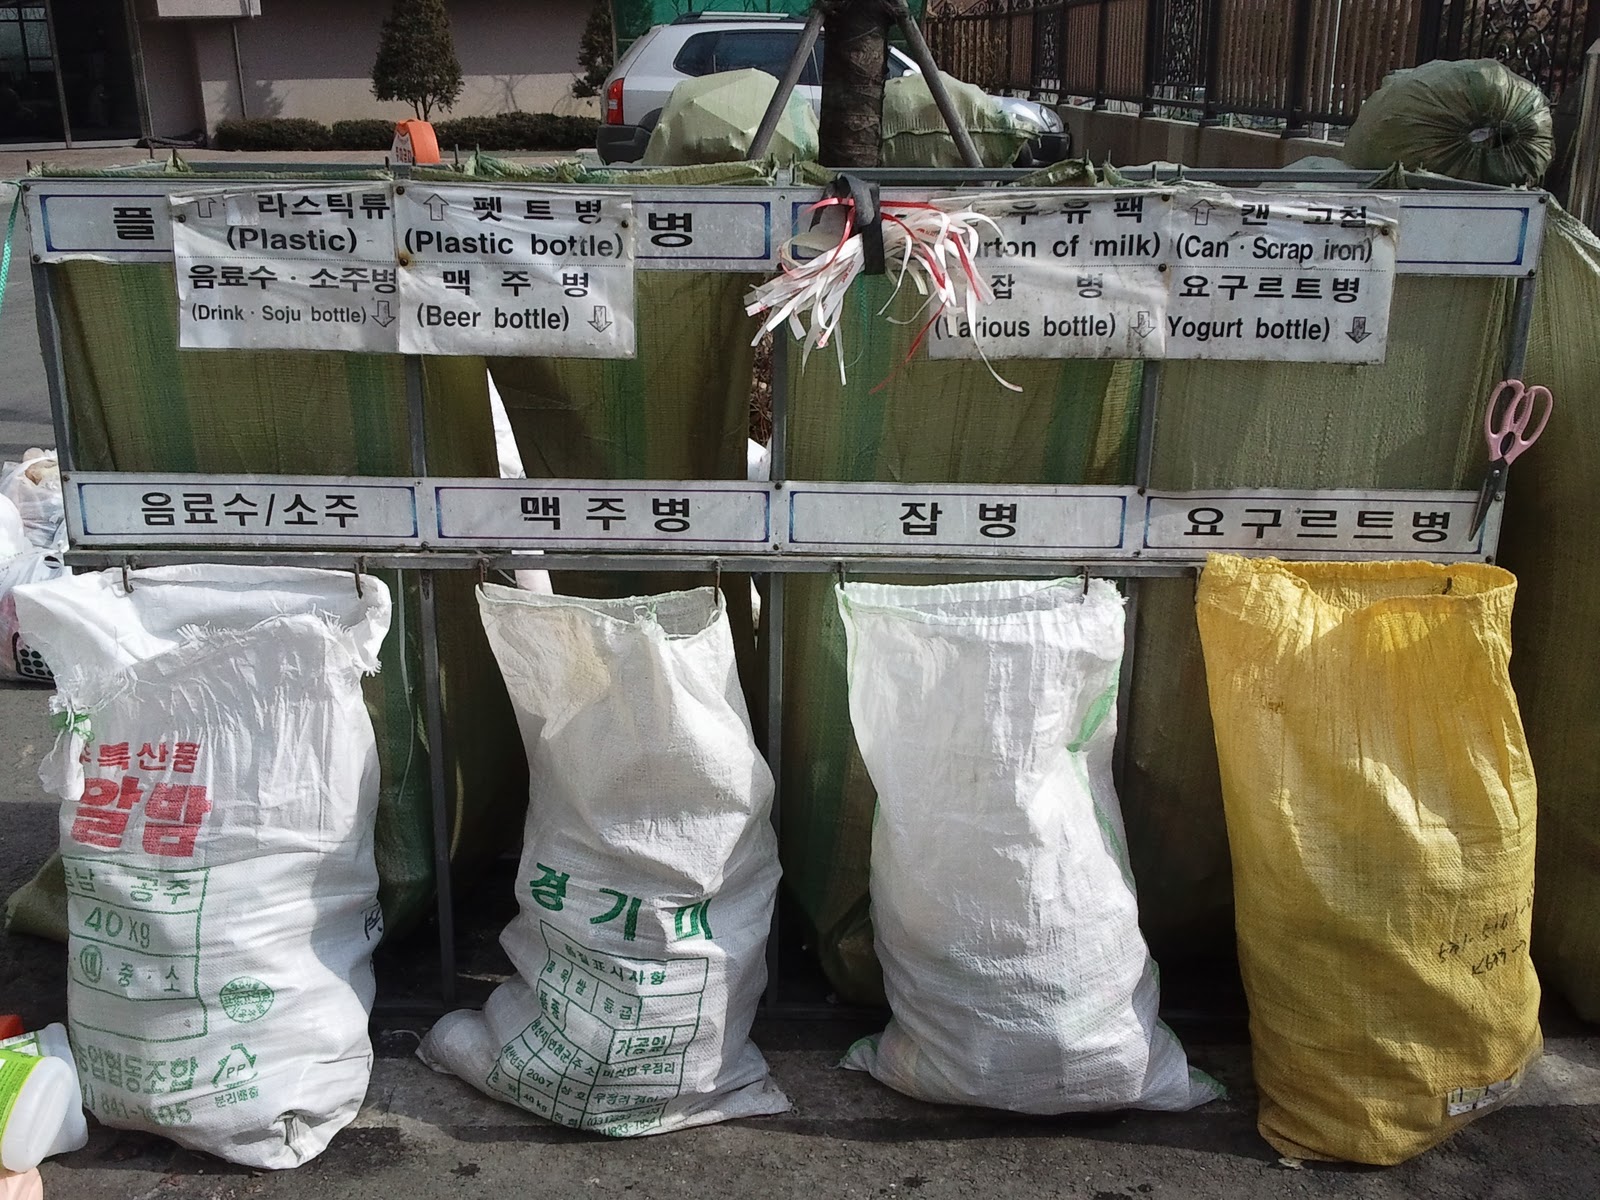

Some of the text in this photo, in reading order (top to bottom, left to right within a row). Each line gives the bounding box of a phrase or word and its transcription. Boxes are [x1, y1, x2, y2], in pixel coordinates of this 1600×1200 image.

[113, 206, 155, 241] 플
[648, 211, 693, 248] 병
[226, 226, 358, 253] (Plastic)
[404, 227, 624, 260] (Plastic bottle)
[1052, 234, 1080, 258] of
[1094, 231, 1160, 259] milk)
[1175, 233, 1374, 264] (Can Scrap iron)
[1178, 275, 1361, 303] 요구르트병
[191, 303, 367, 325] (Drink Soju bottle)
[416, 305, 571, 331] (Beer bottle)
[1042, 311, 1116, 339] bottle)
[1167, 316, 1331, 343] Yogurt bottle)
[140, 491, 360, 530] 음료수/소주
[1183, 509, 1451, 543] 요구르트병
[79, 741, 200, 773] 특산품
[69, 775, 213, 857] 알밤
[525, 1068, 554, 1088] 2007
